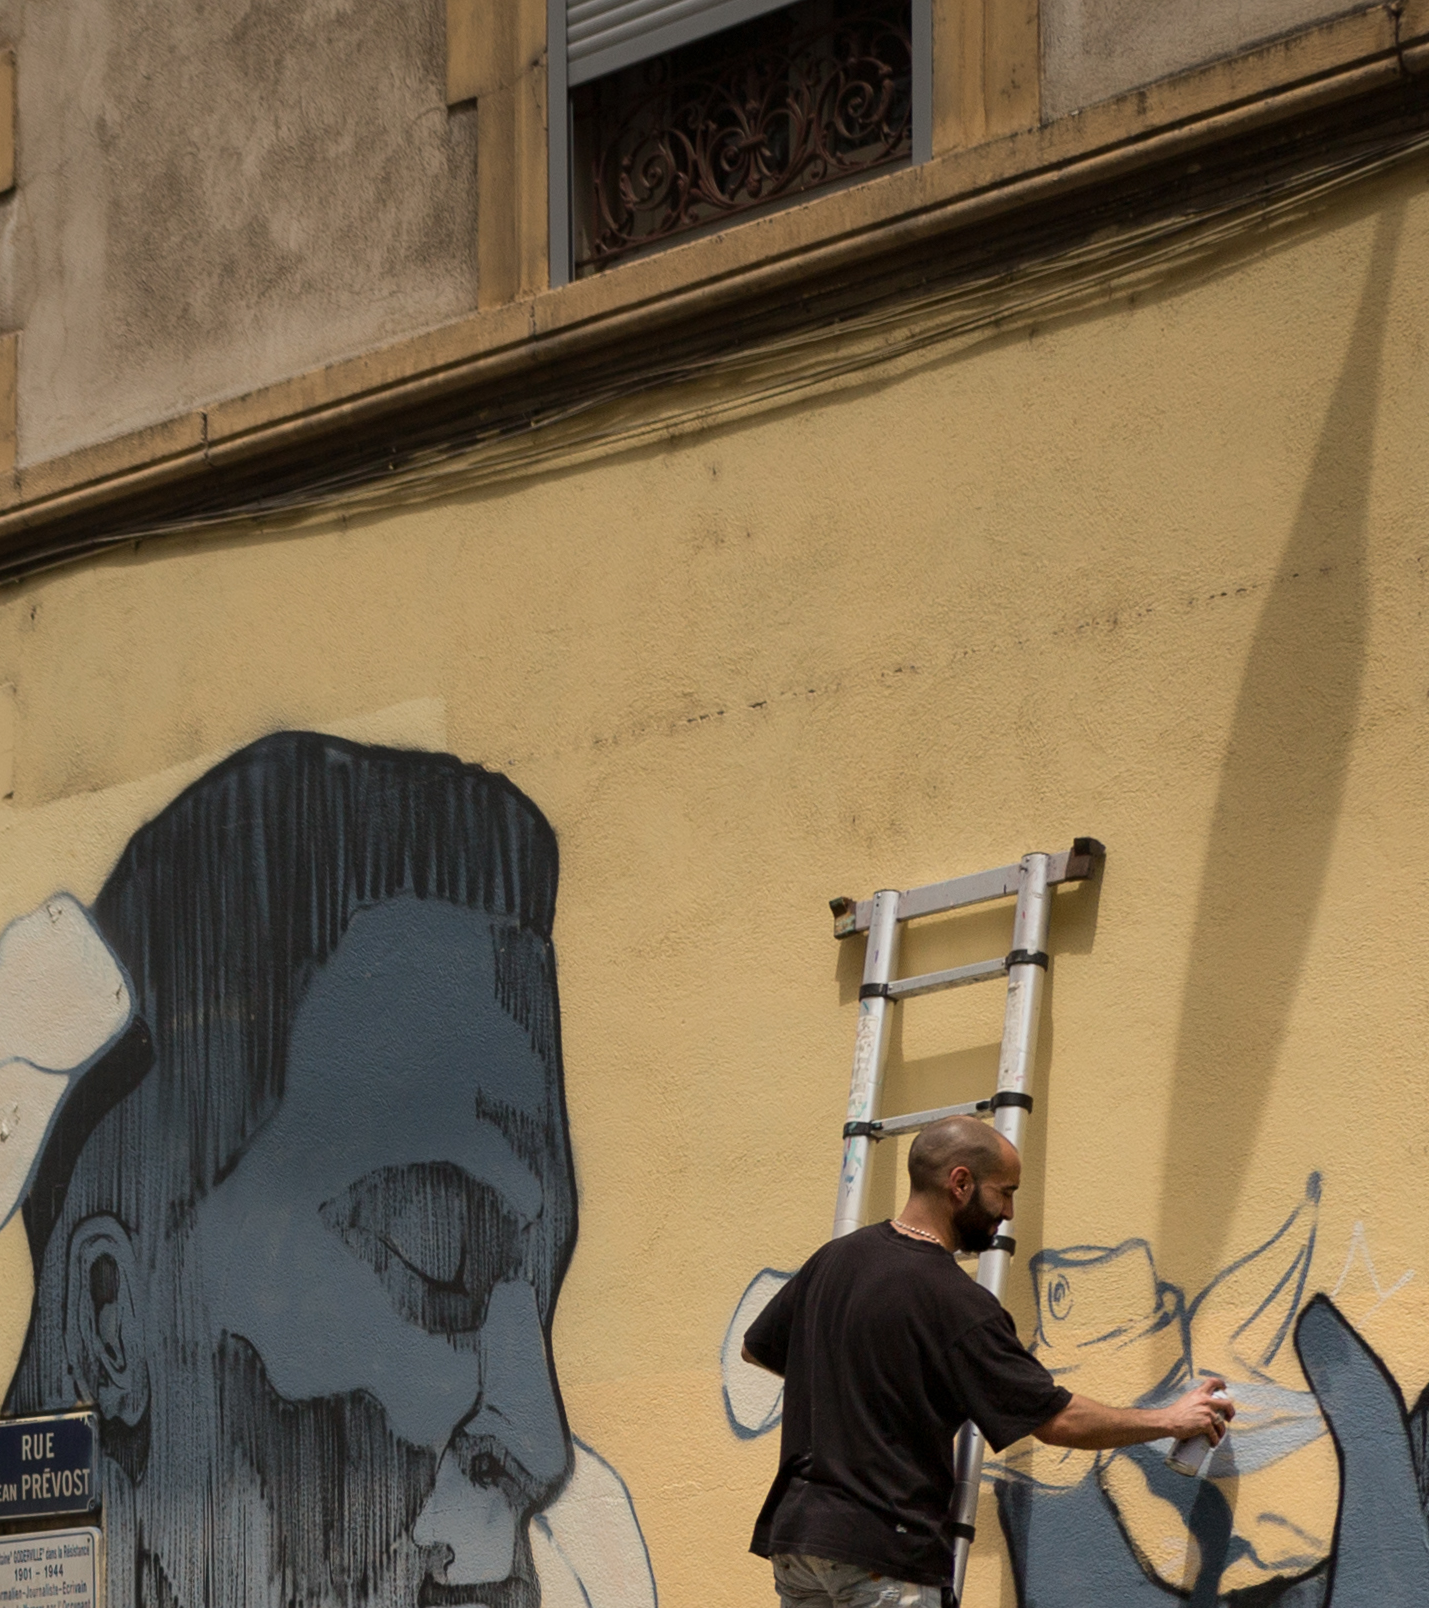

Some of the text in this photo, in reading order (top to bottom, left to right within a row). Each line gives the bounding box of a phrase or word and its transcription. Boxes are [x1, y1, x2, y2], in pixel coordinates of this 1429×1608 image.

[22, 1432, 55, 1461] RUE
[21, 1467, 90, 1500] PRÉVOST
[14, 1567, 32, 1581] 1901
[44, 1563, 64, 1578] 1944
